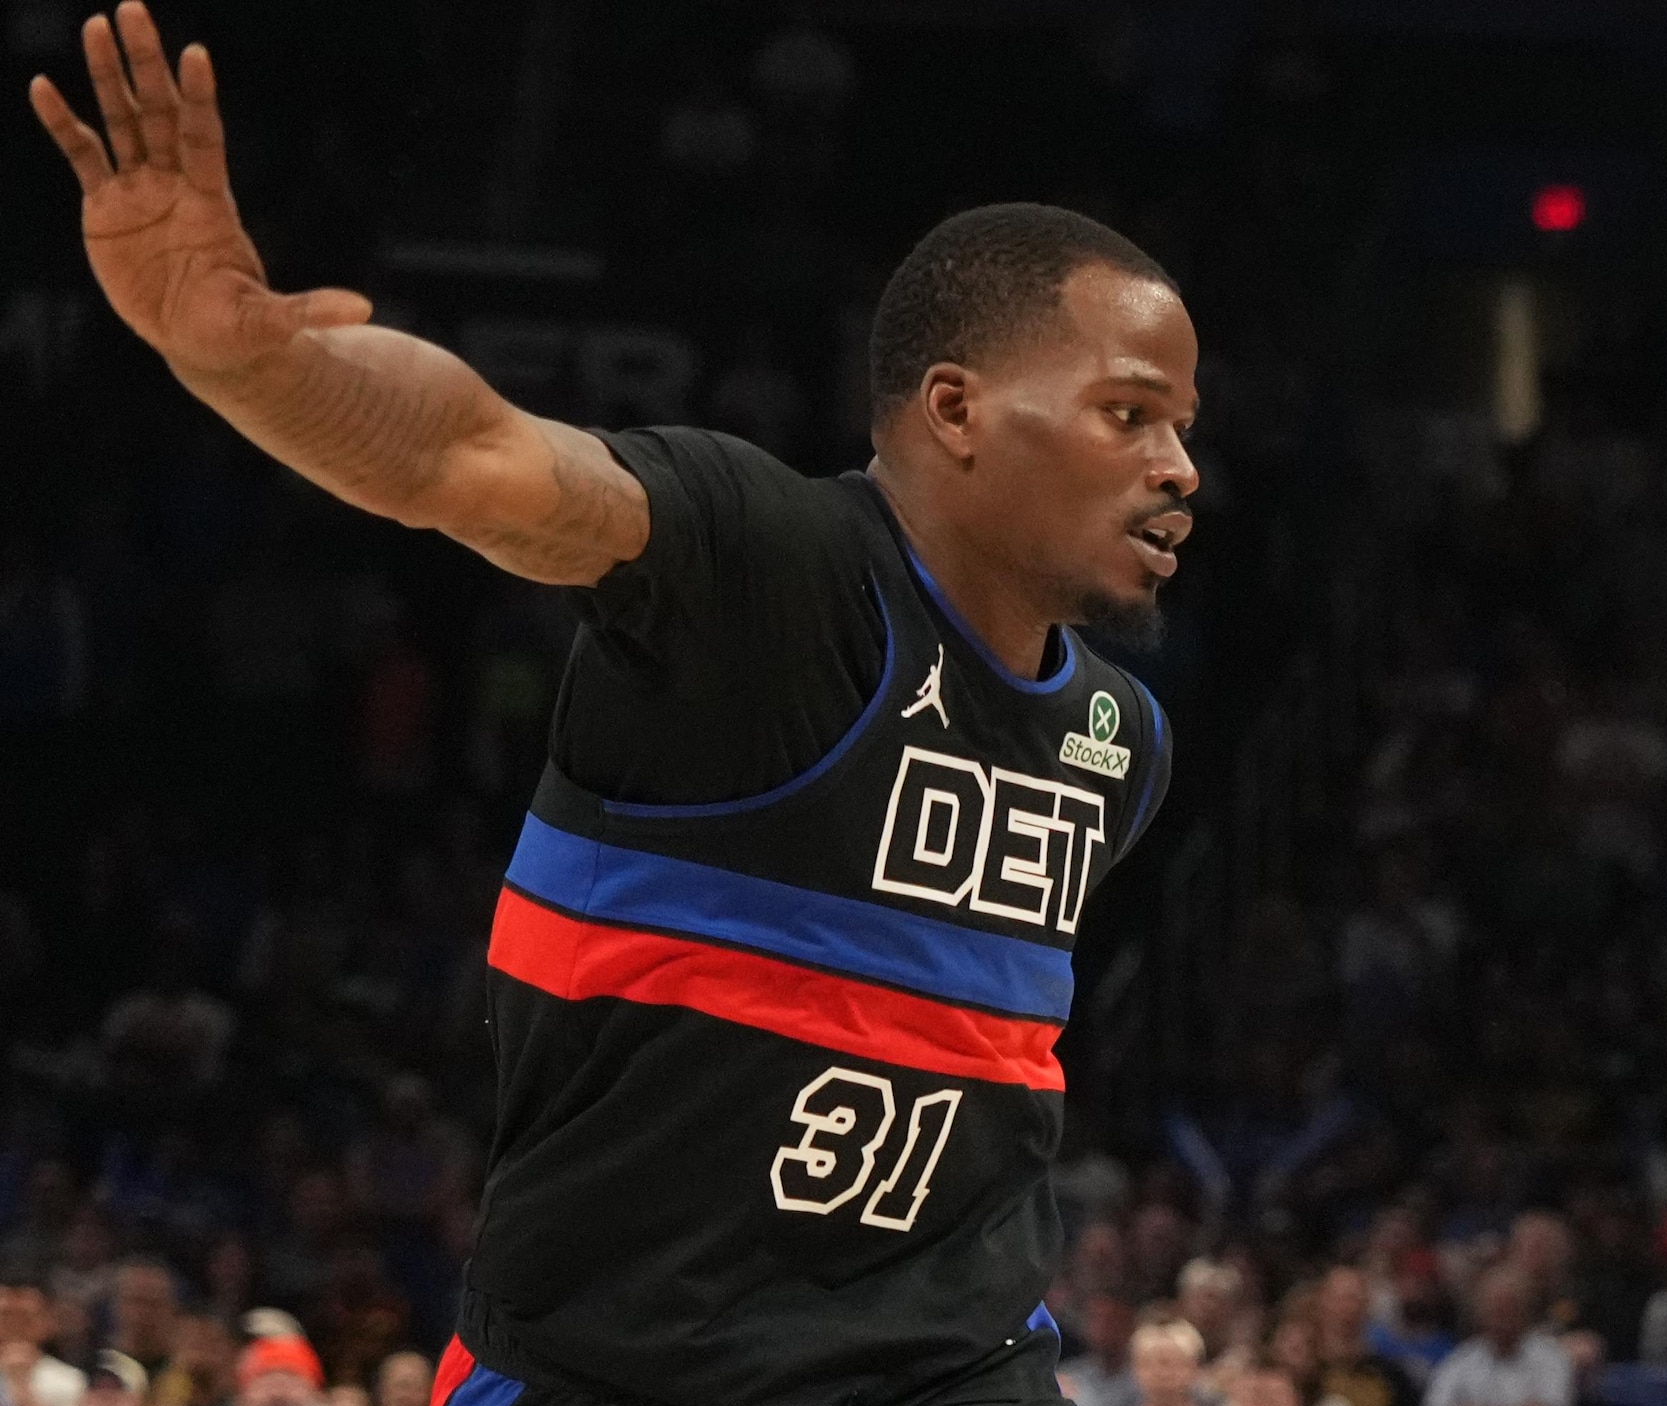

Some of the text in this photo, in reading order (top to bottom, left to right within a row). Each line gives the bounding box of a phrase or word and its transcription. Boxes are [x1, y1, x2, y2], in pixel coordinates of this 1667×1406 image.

[1063, 737, 1128, 772] StockX
[872, 745, 1105, 934] DET
[770, 1066, 963, 1232] 31
